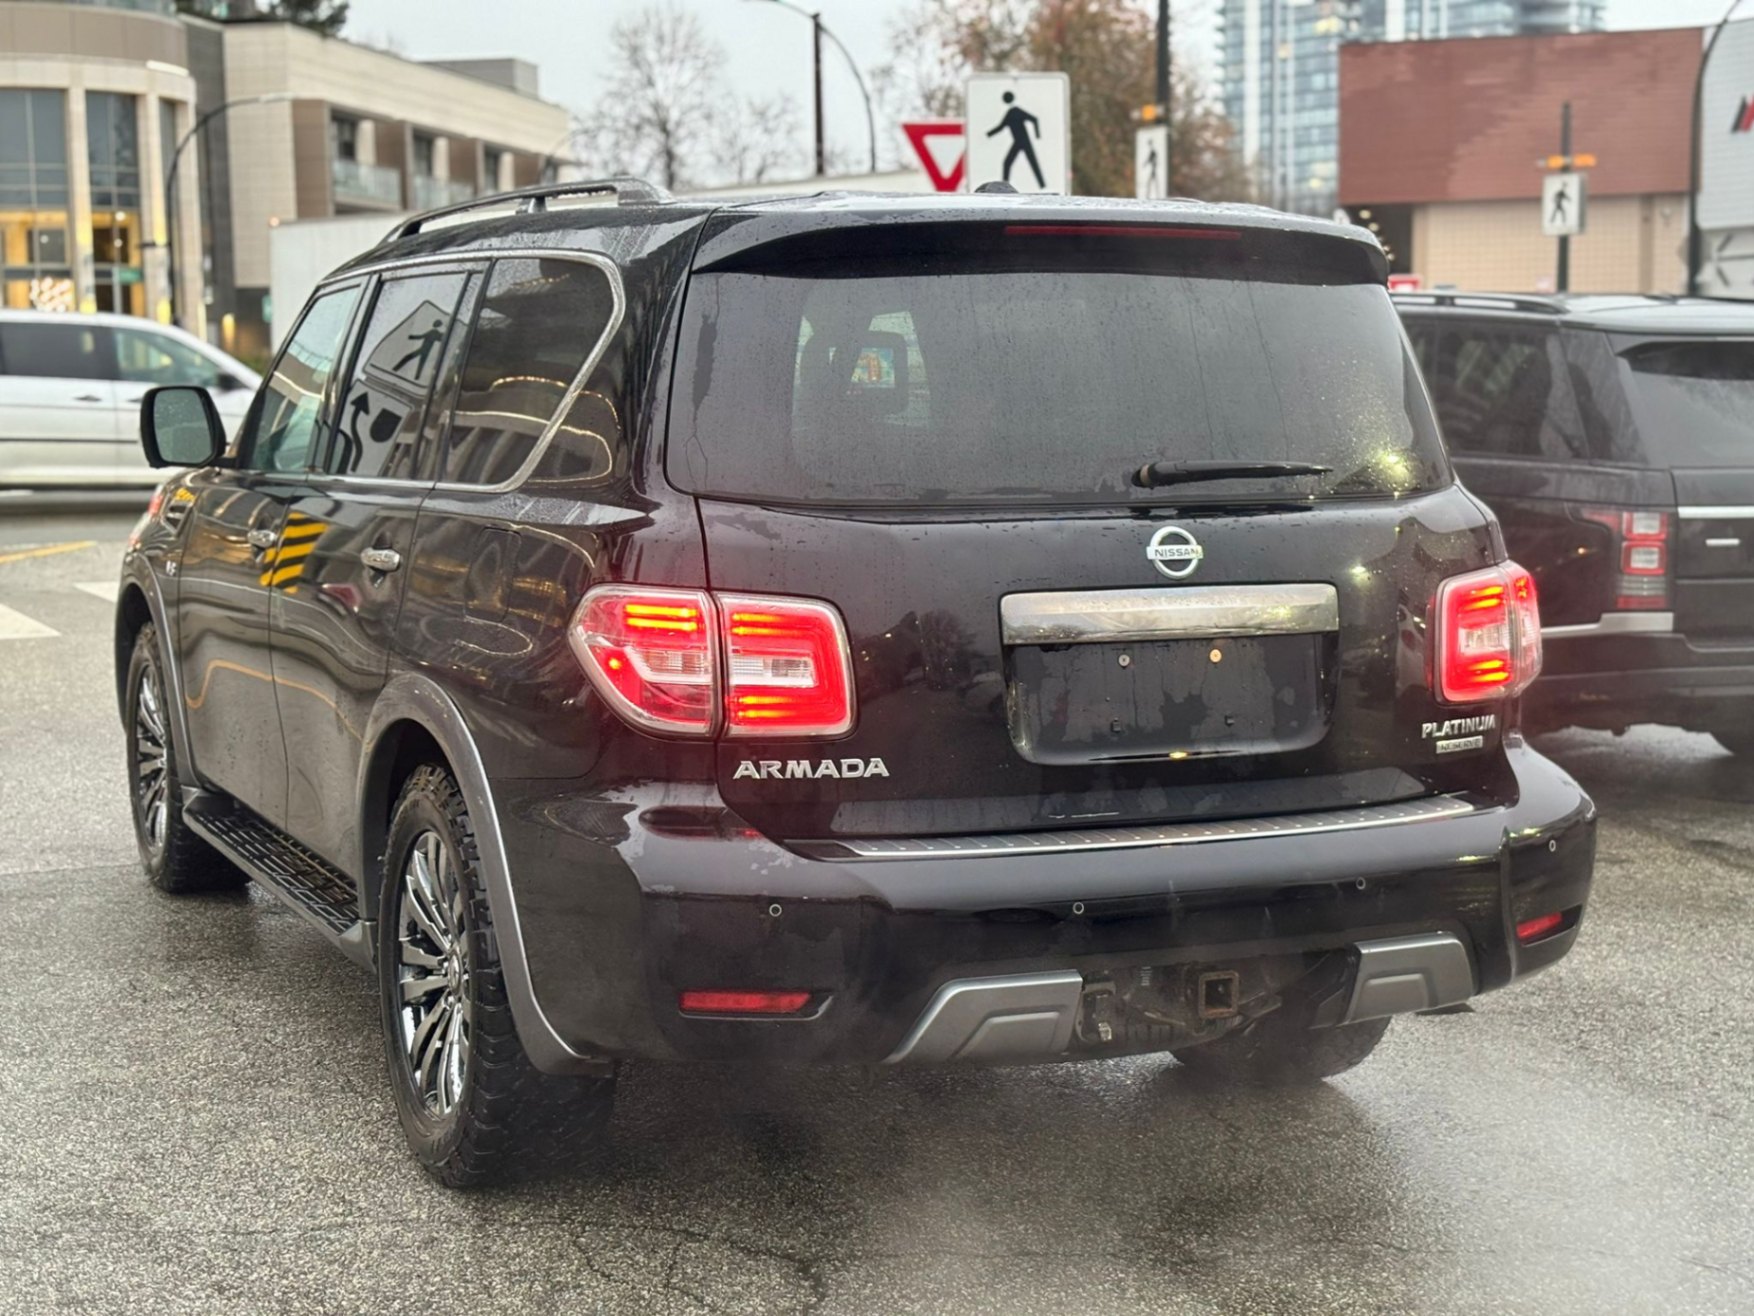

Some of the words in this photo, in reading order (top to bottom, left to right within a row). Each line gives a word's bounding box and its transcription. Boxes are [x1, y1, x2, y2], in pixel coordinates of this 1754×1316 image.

[1154, 547, 1200, 558] NISSAN
[1421, 714, 1496, 738] PLATINUM
[732, 757, 890, 780] ARMADA
